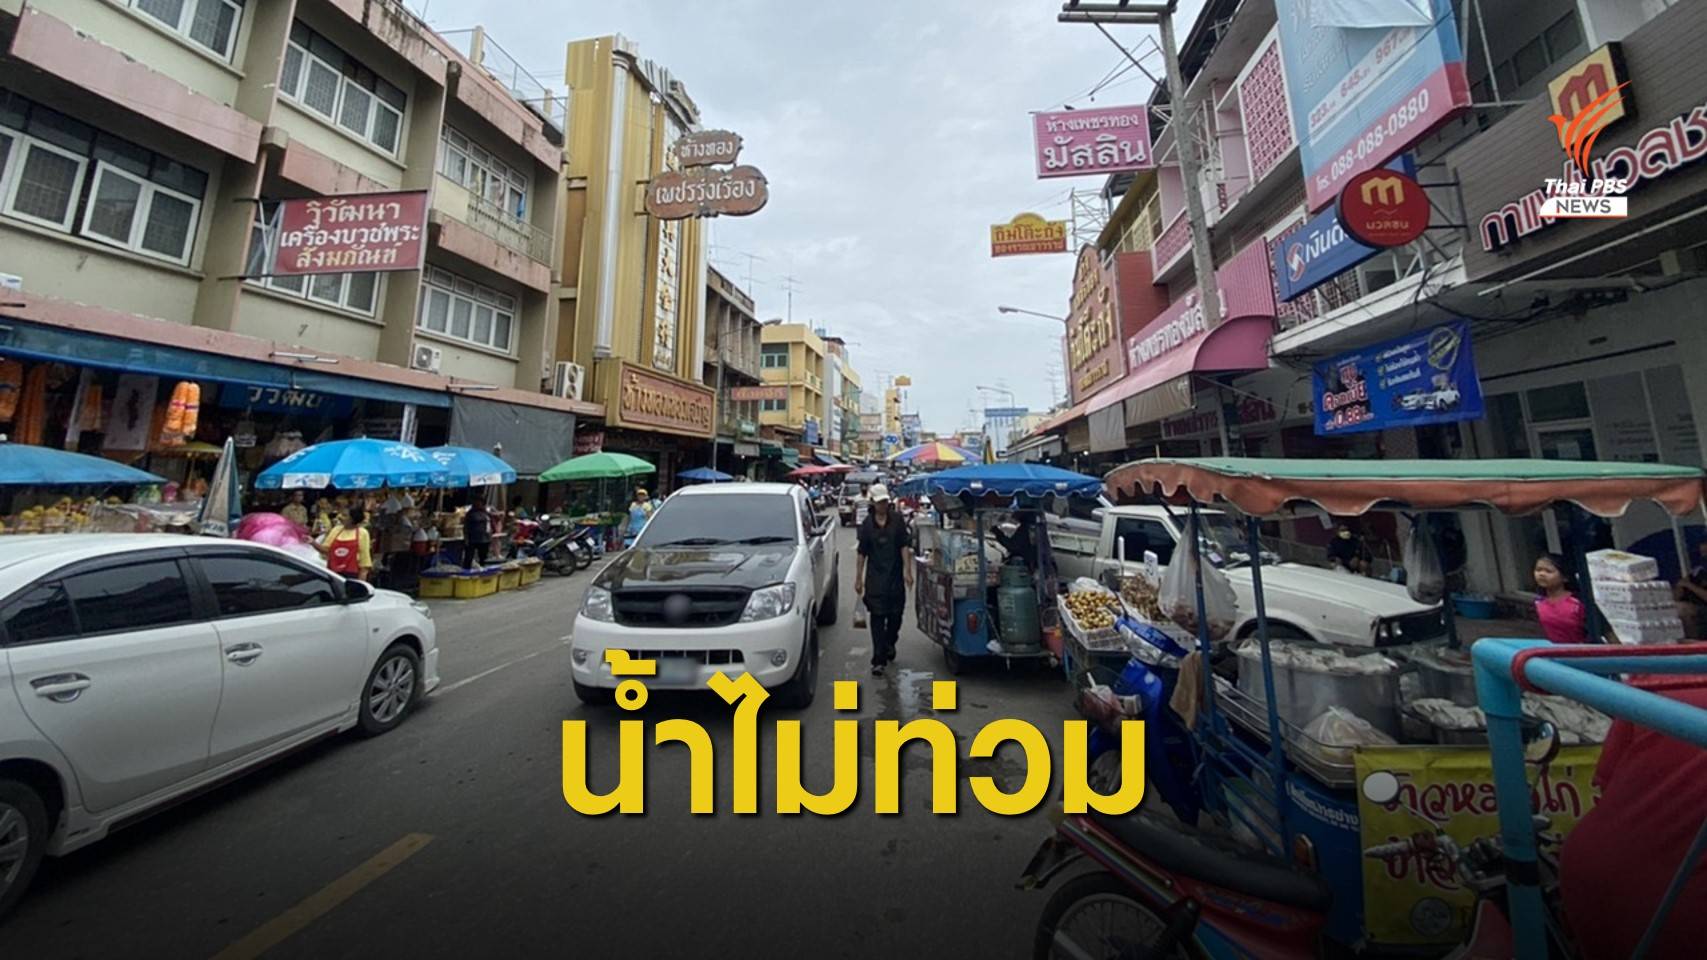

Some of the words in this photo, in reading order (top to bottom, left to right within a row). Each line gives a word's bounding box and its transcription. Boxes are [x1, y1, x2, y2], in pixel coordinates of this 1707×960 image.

[1045, 113, 1139, 133] ห้างเพชรทอง
[1331, 88, 1430, 181] 088-088-0880
[1044, 133, 1148, 169] มัสลิน
[306, 199, 401, 230] วิวัฒนา
